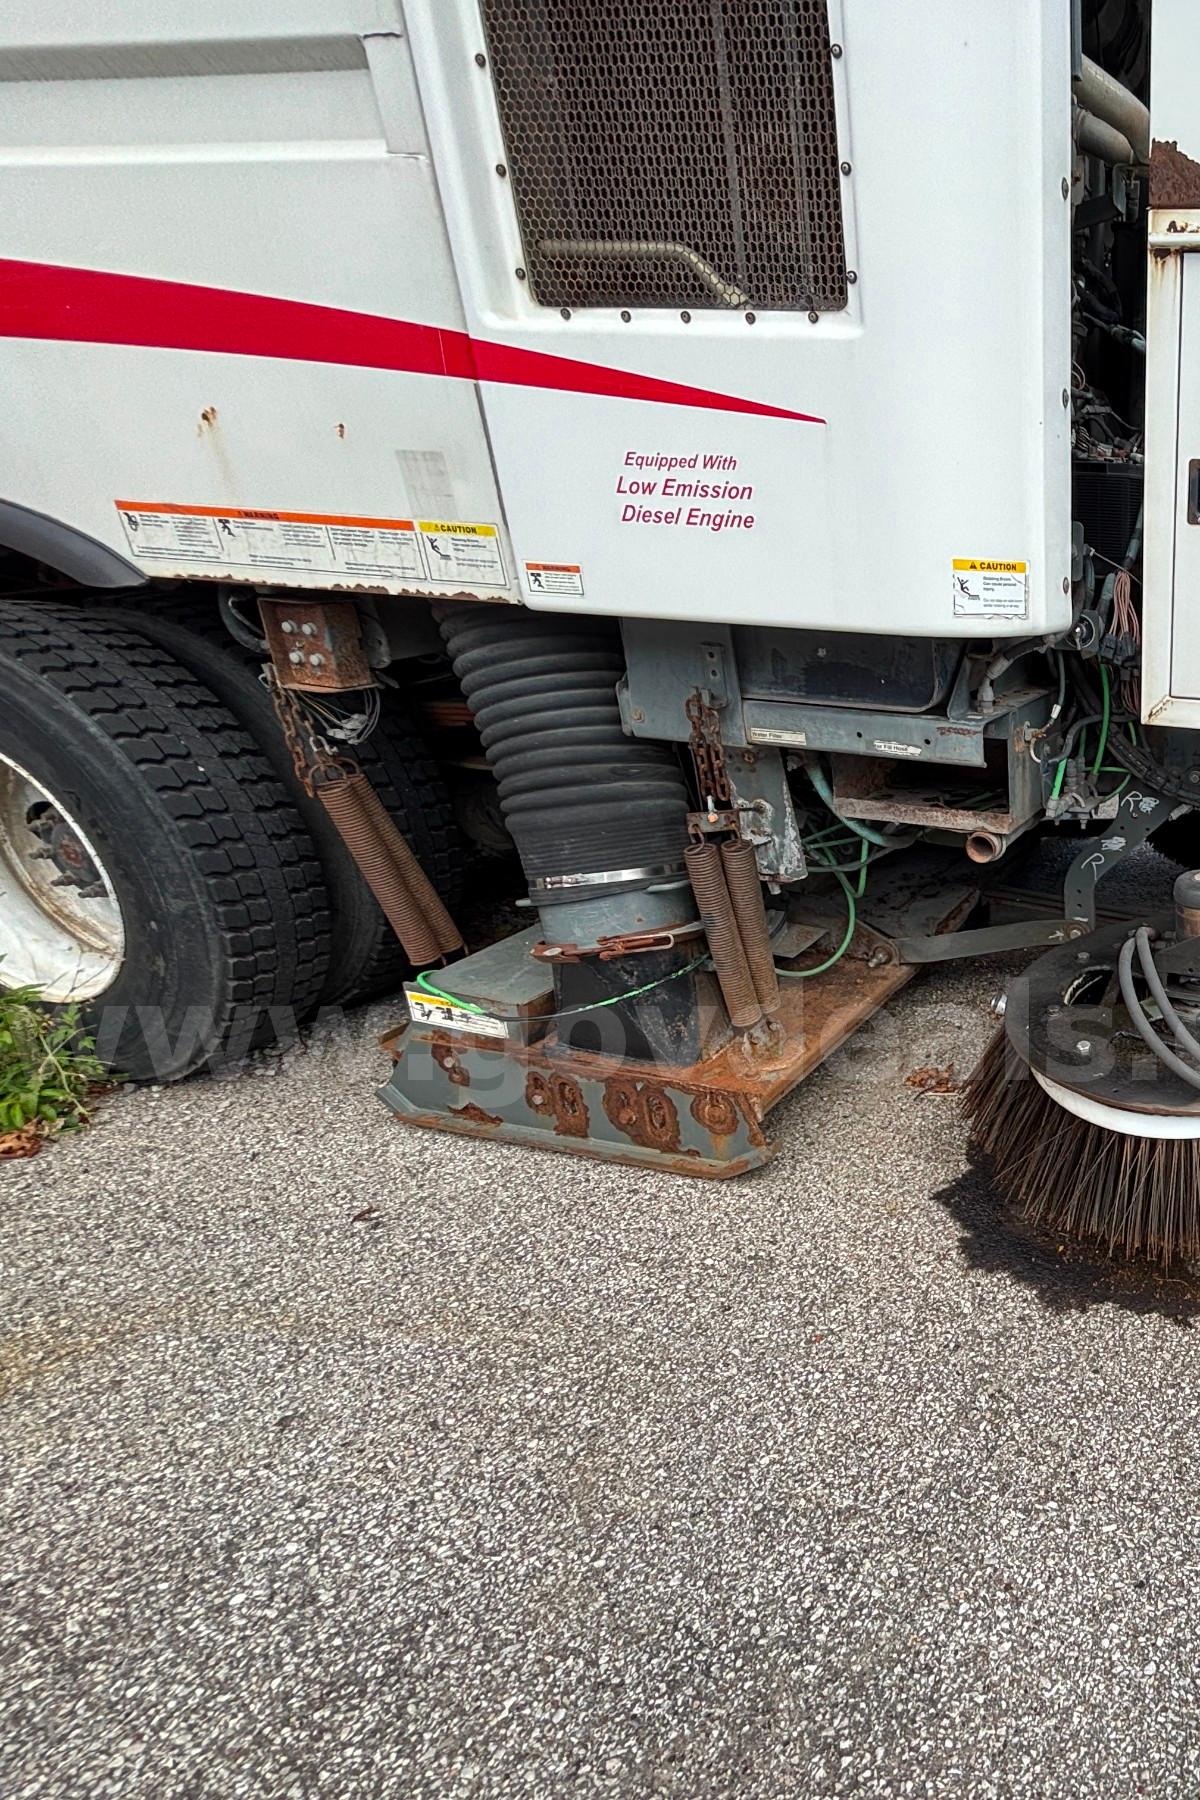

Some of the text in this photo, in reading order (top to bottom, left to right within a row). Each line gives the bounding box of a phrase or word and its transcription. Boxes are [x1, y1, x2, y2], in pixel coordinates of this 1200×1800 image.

[623, 451, 738, 472] Equipped With
[616, 475, 753, 501] Low Emission
[621, 504, 755, 532] Diesel Engine
[440, 524, 478, 535] CAUTION
[979, 561, 1017, 571] CAUTION
